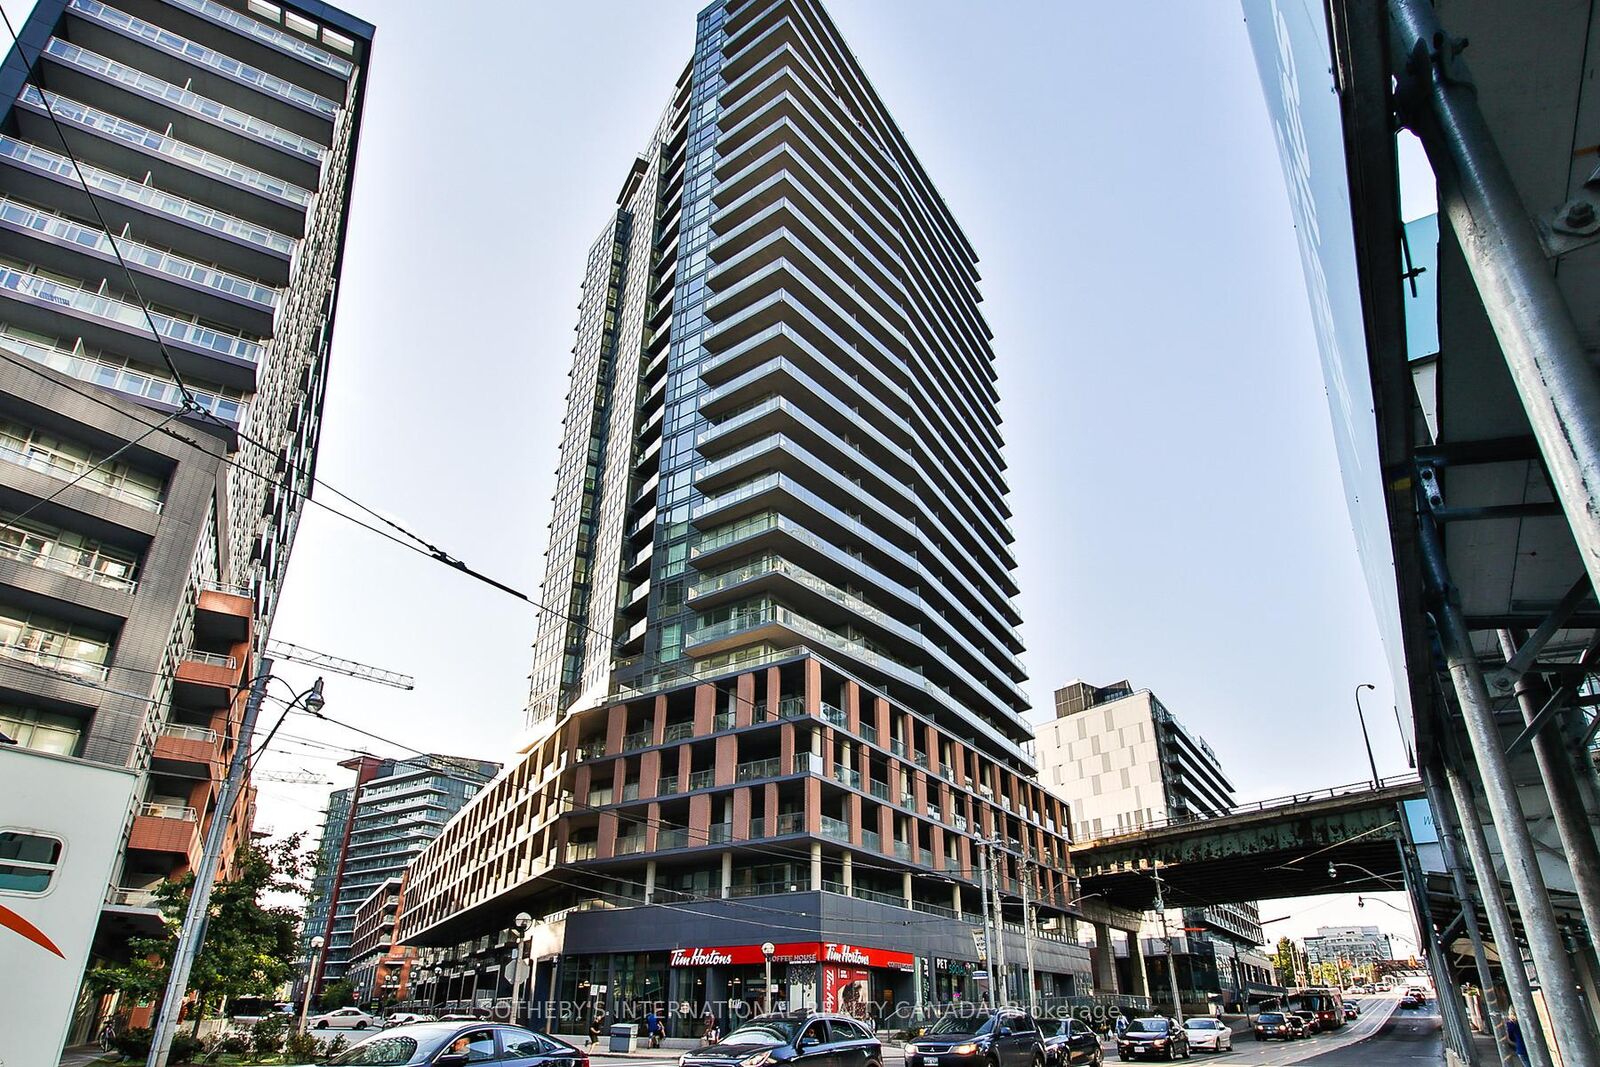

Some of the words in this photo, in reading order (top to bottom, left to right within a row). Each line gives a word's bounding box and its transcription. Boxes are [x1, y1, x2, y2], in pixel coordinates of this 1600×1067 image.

[671, 949, 690, 966] Tim
[691, 947, 732, 965] Hortons
[825, 943, 840, 962] Tim
[841, 944, 869, 966] Hortons
[936, 958, 948, 970] PET
